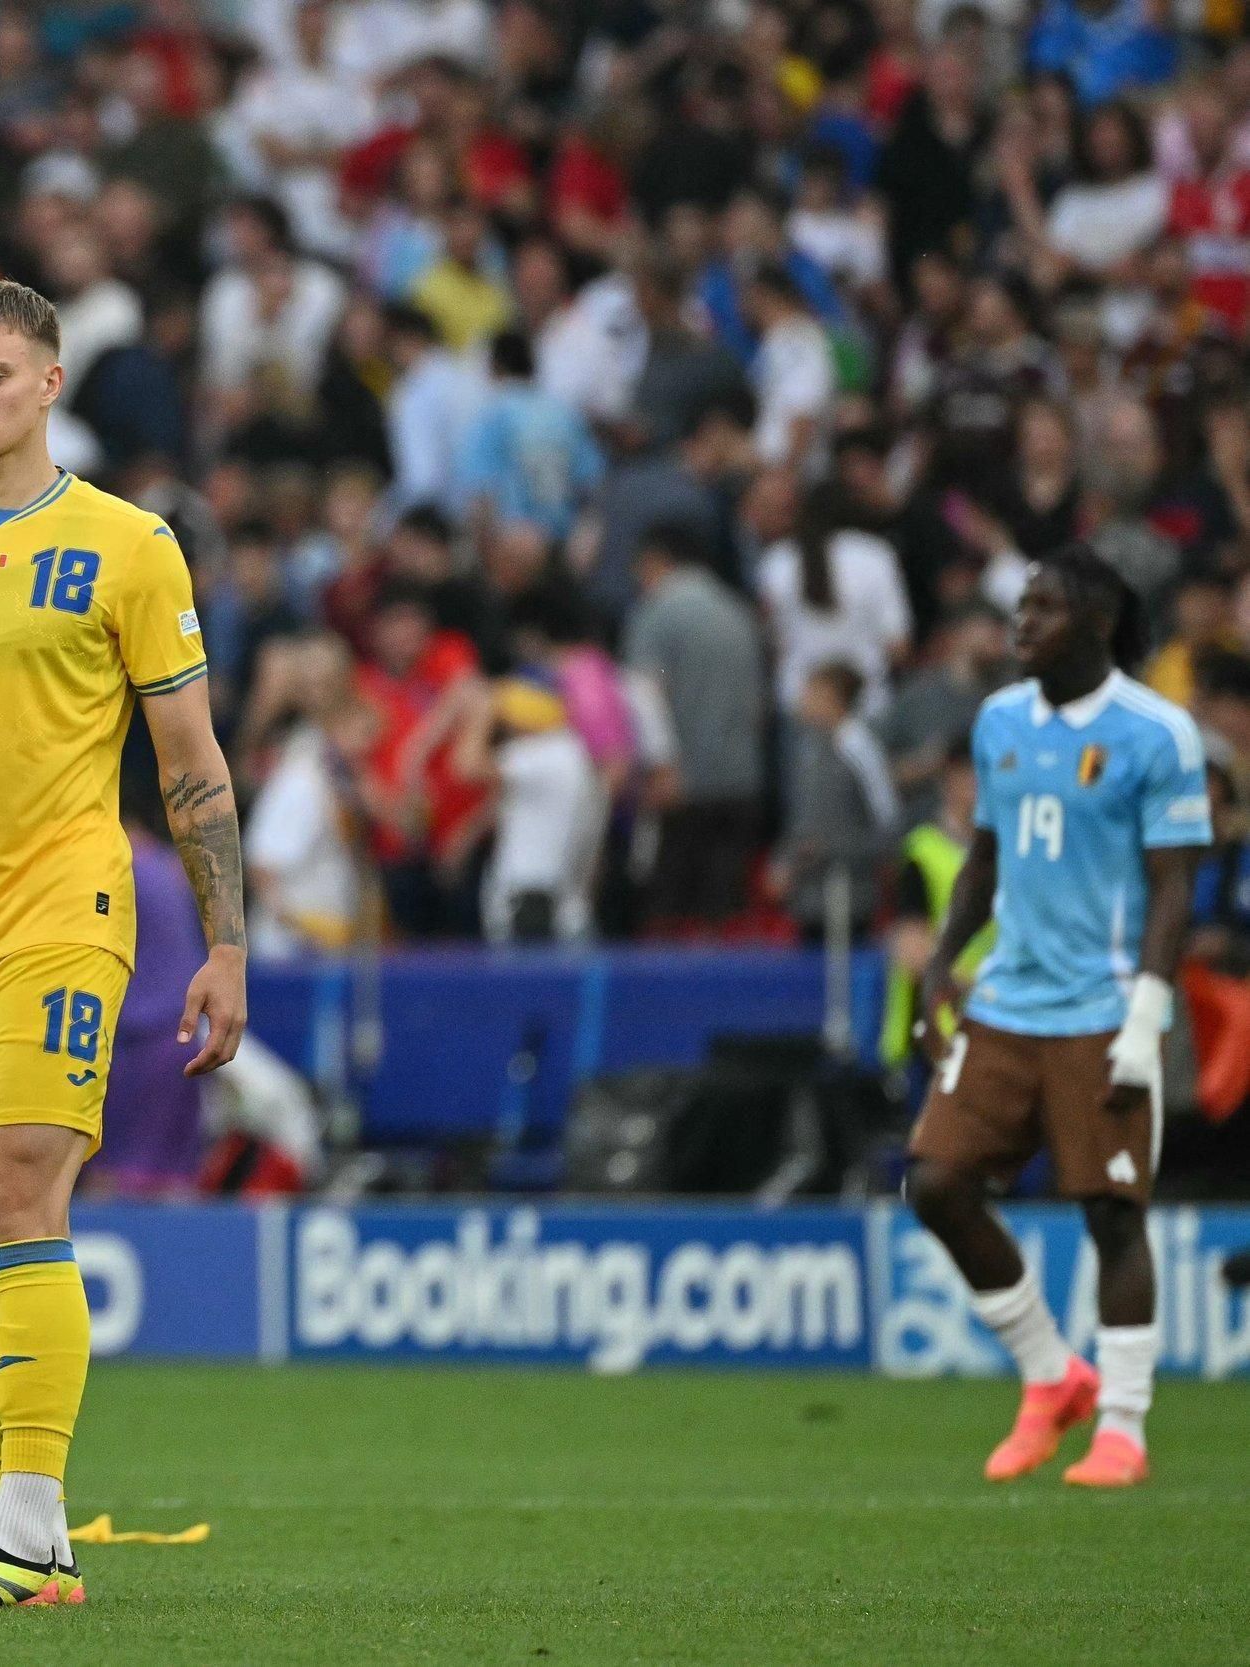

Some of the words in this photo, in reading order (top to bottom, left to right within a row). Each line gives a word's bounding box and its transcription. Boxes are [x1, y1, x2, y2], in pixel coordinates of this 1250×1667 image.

[30, 546, 102, 615] 18
[1017, 794, 1064, 862] 19
[41, 986, 103, 1064] 18
[297, 1205, 859, 1375] Booking.com
